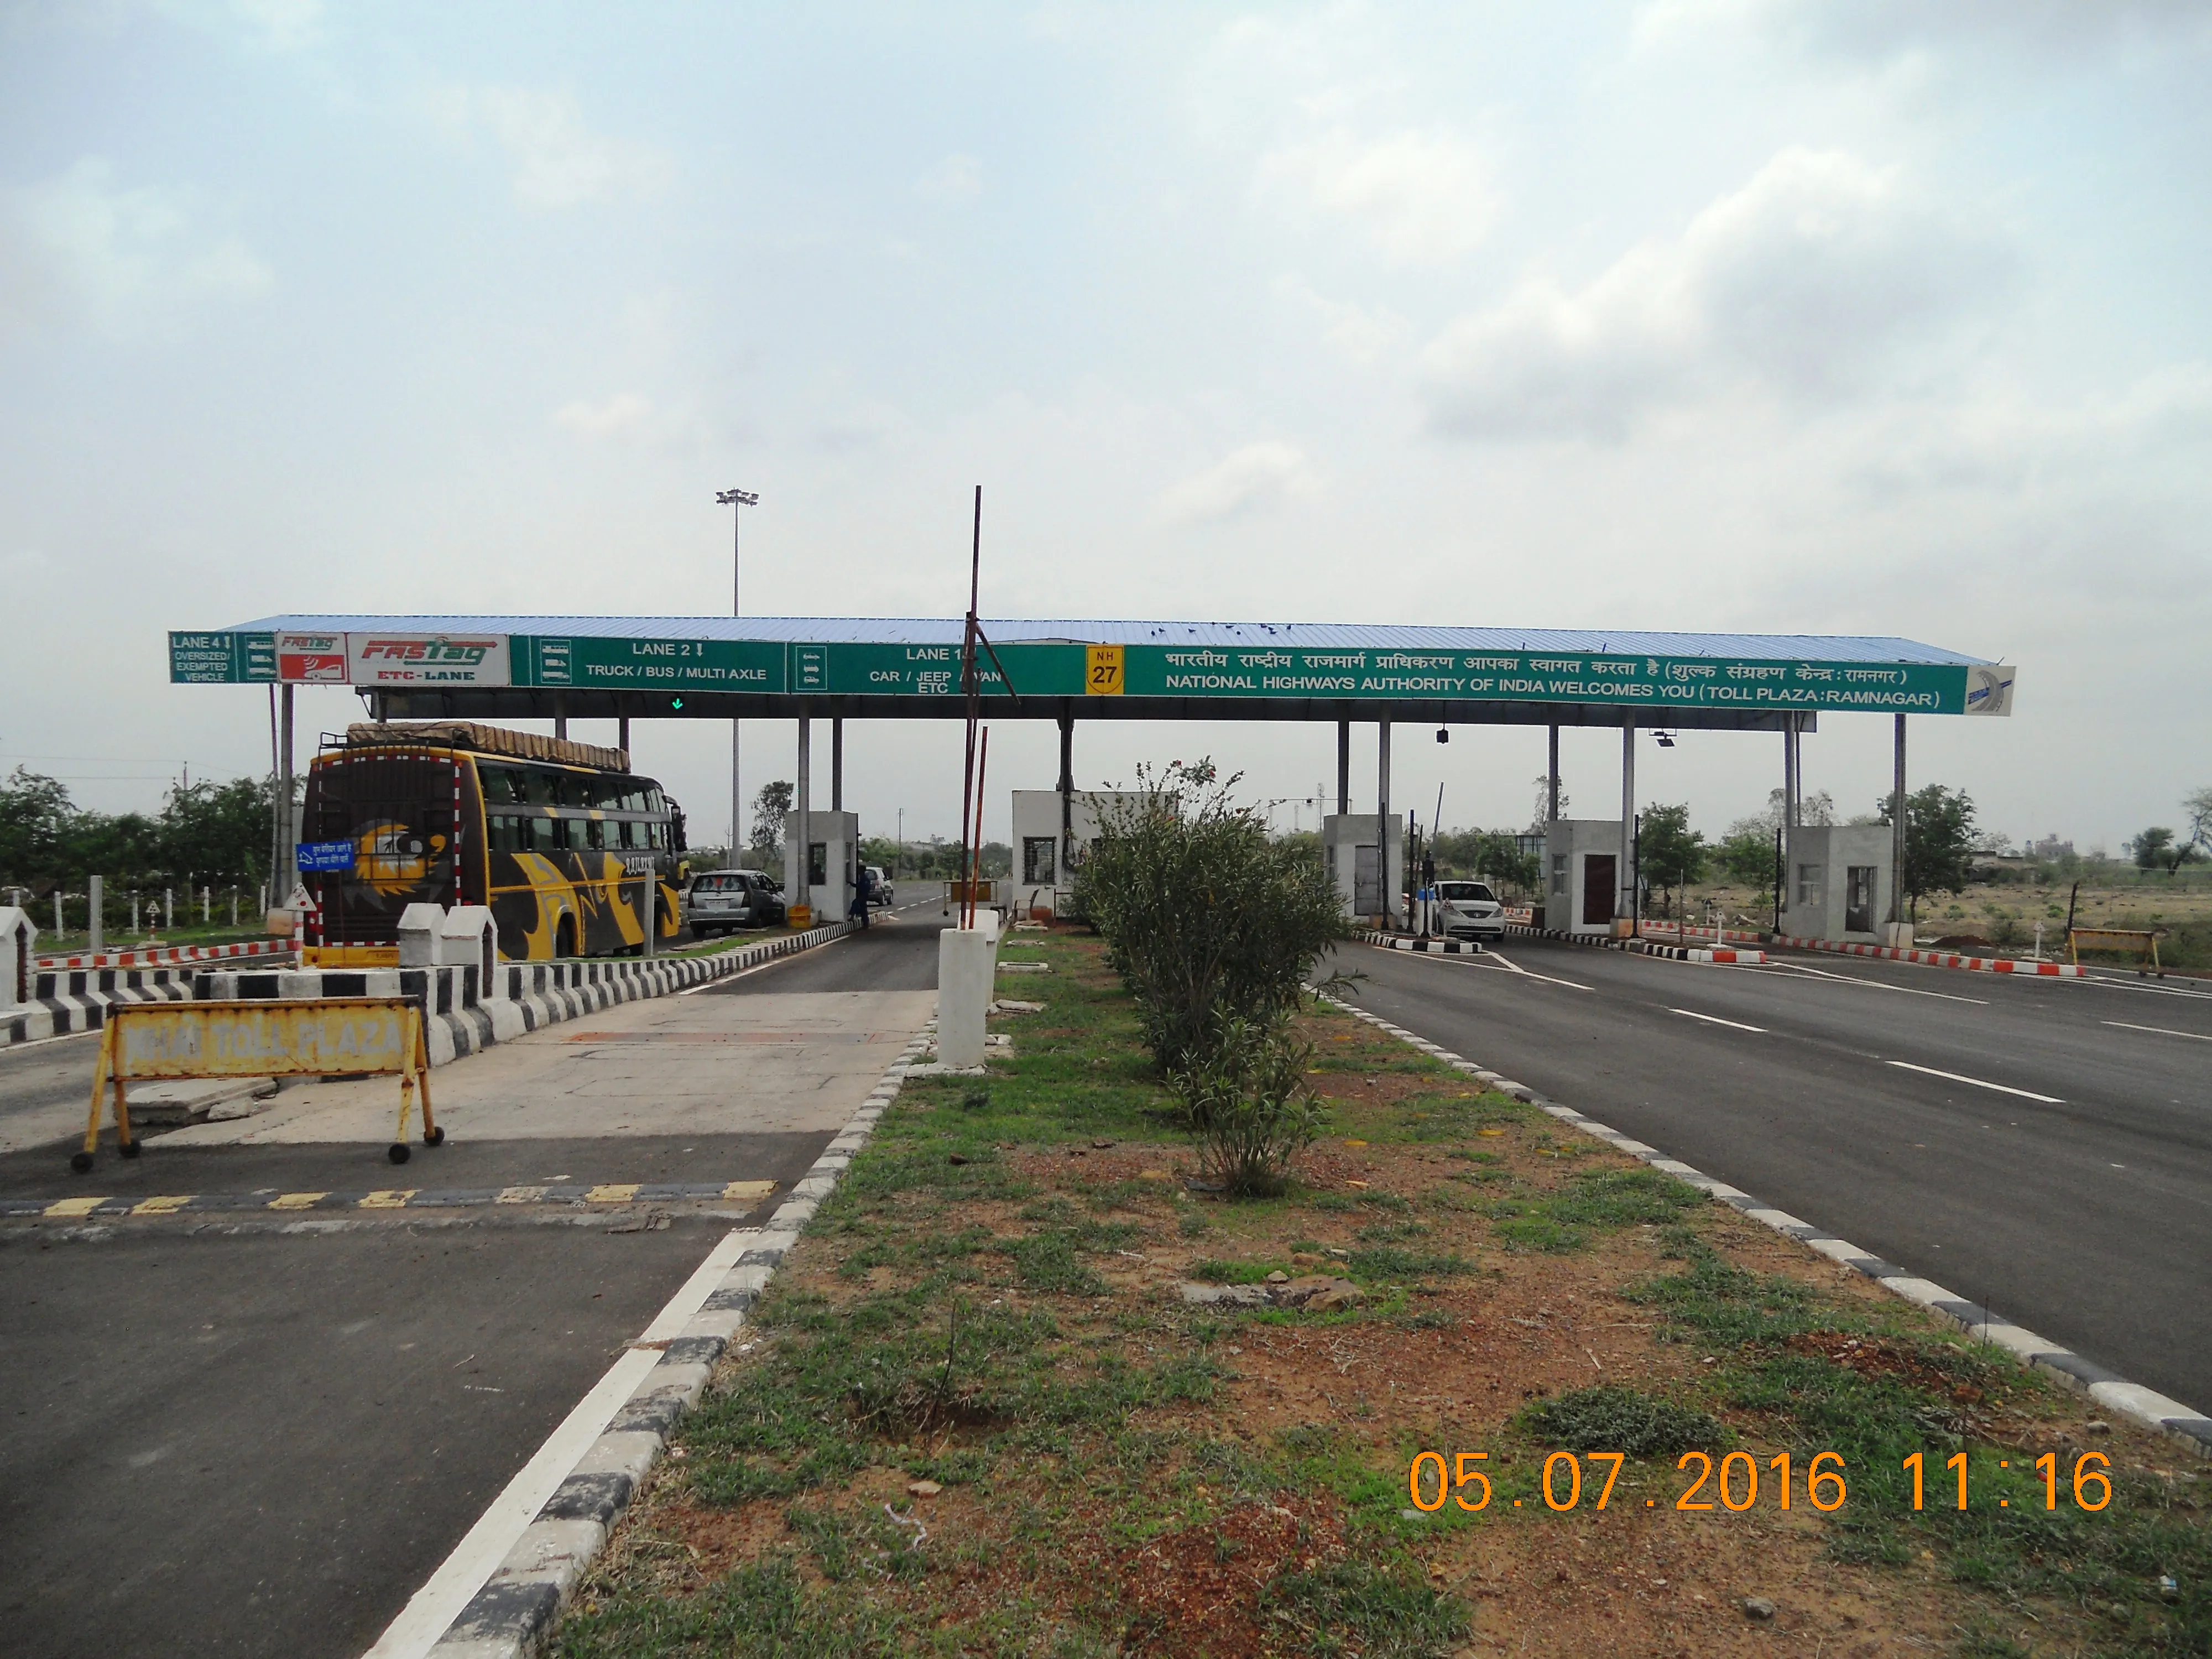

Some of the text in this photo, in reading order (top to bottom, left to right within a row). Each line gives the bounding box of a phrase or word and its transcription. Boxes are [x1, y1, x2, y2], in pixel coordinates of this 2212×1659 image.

[173, 637, 220, 648] LANE 4
[362, 640, 497, 666] FASTag
[633, 643, 690, 656] LANE 2
[907, 648, 950, 660] LANE
[177, 662, 227, 671] EXEMPTED
[1165, 650, 1228, 667] भारतीय
[1238, 651, 1292, 668] राष्ट्रीय
[1302, 651, 1366, 669] राजमार्ग
[1375, 653, 1455, 669] प्राधिकरण
[1463, 658, 1520, 671] आपका
[1529, 659, 1582, 673] स्वागत
[1591, 661, 1637, 675] करता
[1646, 658, 1660, 676] है
[1725, 662, 1787, 680] संग्रहण
[185, 673, 225, 682] VEHICLE
[586, 665, 634, 676] TRUCK
[646, 667, 674, 677] BUS
[686, 667, 725, 679] MULTI
[729, 669, 766, 680] AXLE
[870, 671, 900, 681] CAR
[916, 671, 952, 682] JEEP
[1092, 666, 1118, 684] 27
[919, 682, 948, 693] ETC
[1166, 675, 1257, 688] NATIONAL
[1263, 676, 1355, 690] HIGHWAYS
[1361, 677, 1465, 691] AUTHORITY
[1470, 679, 1494, 691] OF
[1499, 679, 1545, 692] INDIA
[1549, 681, 1653, 696] WELCOMES
[1658, 685, 1694, 698] YOU
[211, 1023, 289, 1057] TOLL
[298, 1021, 404, 1055] PLAZA
